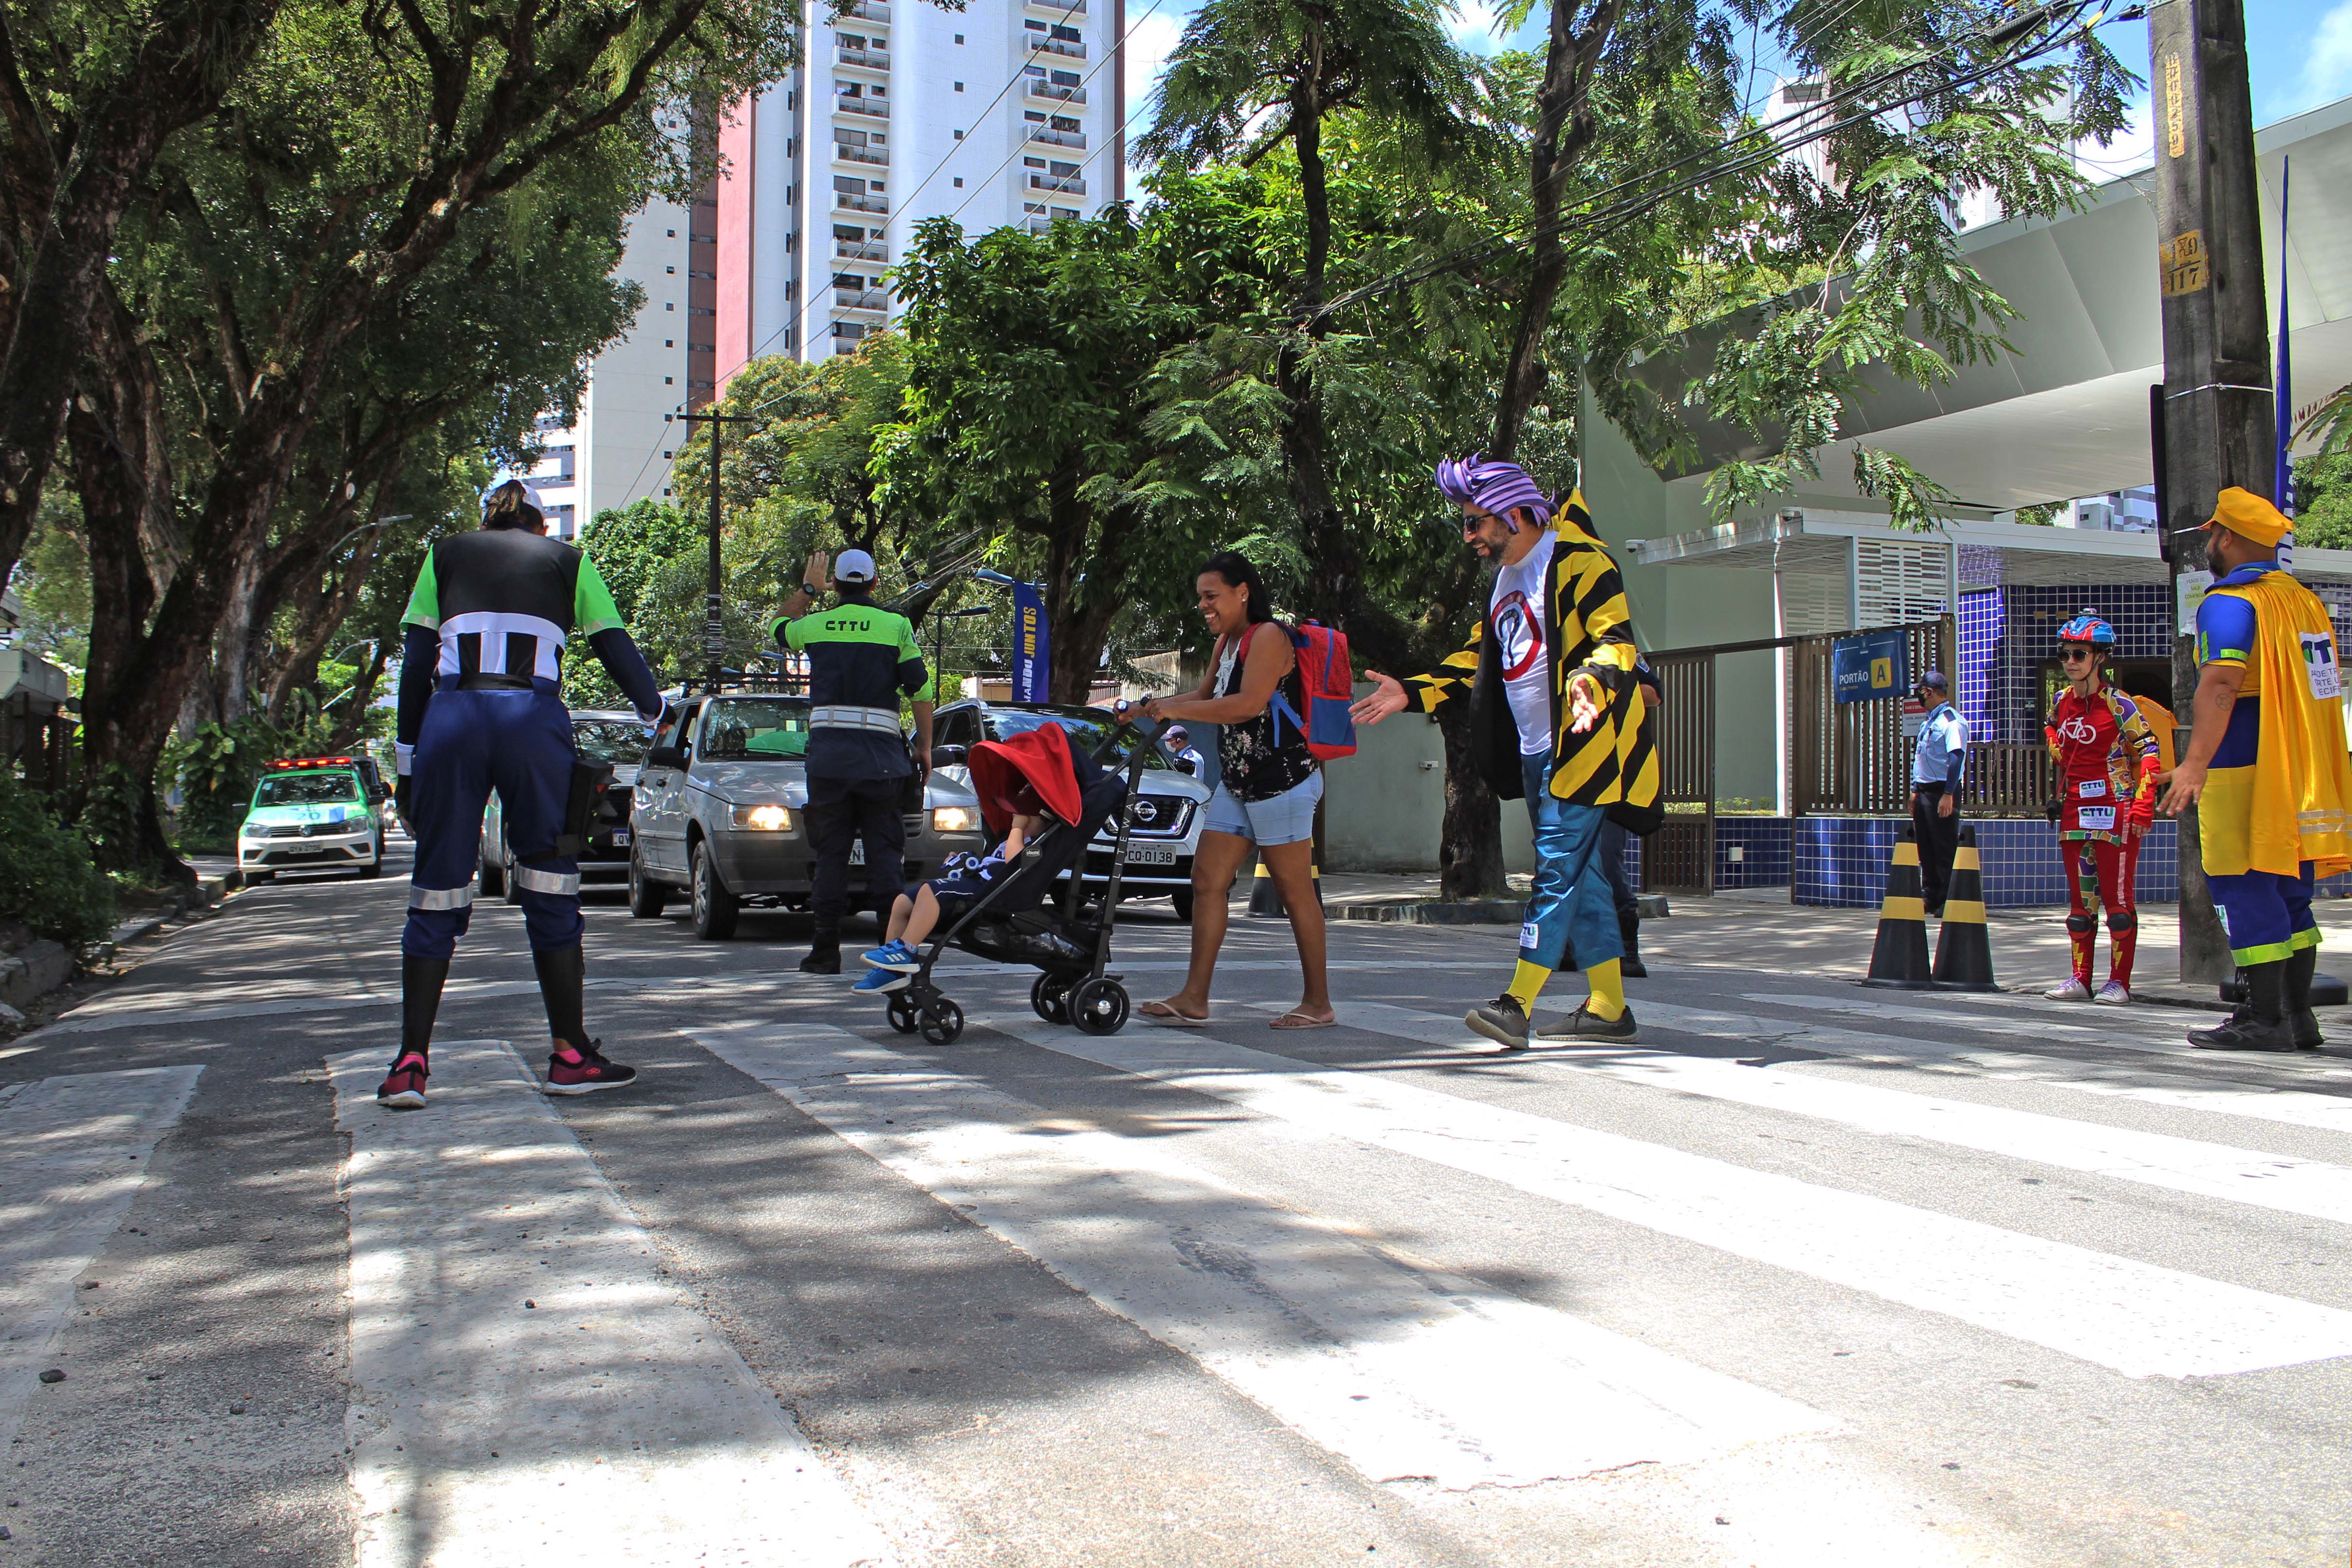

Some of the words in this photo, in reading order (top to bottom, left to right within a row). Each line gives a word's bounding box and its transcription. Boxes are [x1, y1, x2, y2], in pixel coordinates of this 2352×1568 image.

[826, 620, 870, 631] CTTU
[1023, 607, 1036, 658] JUNTOS
[1839, 670, 1868, 685] PORTÃO
[1876, 664, 1886, 683] A
[2081, 781, 2104, 790] CTTU
[2081, 808, 2114, 816] CTTU
